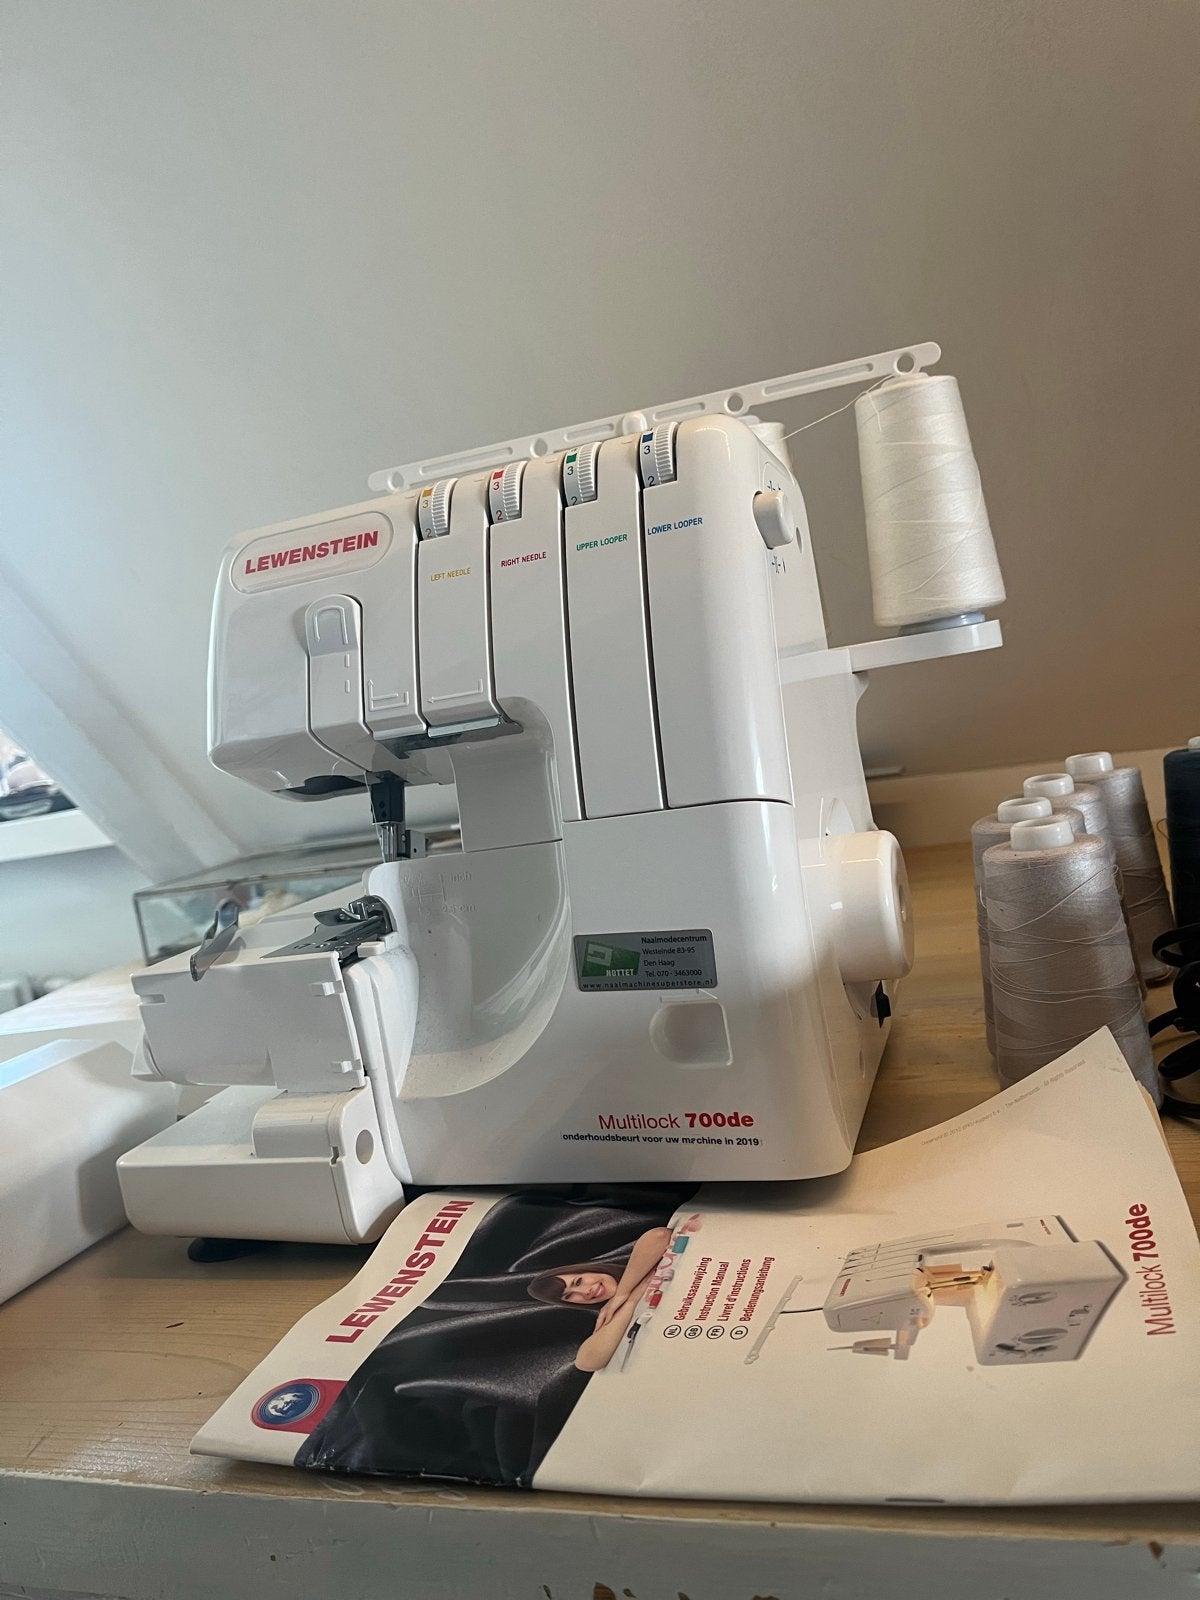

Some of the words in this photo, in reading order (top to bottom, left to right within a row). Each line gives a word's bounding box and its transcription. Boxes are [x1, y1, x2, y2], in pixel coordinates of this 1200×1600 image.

[644, 445, 651, 455] 3
[567, 466, 574, 476] 3
[493, 481, 500, 491] 3
[648, 476, 656, 486] 2
[422, 500, 429, 509] 3
[496, 510, 504, 520] 2
[425, 528, 433, 539] 2
[647, 522, 673, 535] LOWER
[673, 517, 704, 530] LOOPER
[576, 540, 599, 552] UPPER
[600, 534, 628, 546] LOOPER
[245, 531, 379, 574] LEWENSTEIN
[500, 557, 520, 568] RIGHT
[521, 552, 547, 563] NEEDLE
[430, 571, 446, 582] LEFT
[446, 568, 472, 578] NEEDLE
[658, 958, 675, 967] Haag
[598, 1113, 680, 1130] Multilock
[684, 1112, 754, 1128] 700de
[563, 1133, 640, 1144] onderhoudsbeurt
[642, 1136, 662, 1144] voor
[724, 1137, 734, 1146] in
[736, 1137, 760, 1146] 2019
[1125, 1203, 1159, 1262] 700de
[325, 1200, 475, 1344] LEWENSTEIN
[674, 1257, 712, 1320] Gebruiksaanwijzing
[695, 1286, 720, 1321] Instruction
[711, 1261, 730, 1286] Manual
[739, 1256, 776, 1322] Bedienungsanleitung
[1136, 1264, 1176, 1336] Multilock
[716, 1304, 734, 1322] Livret
